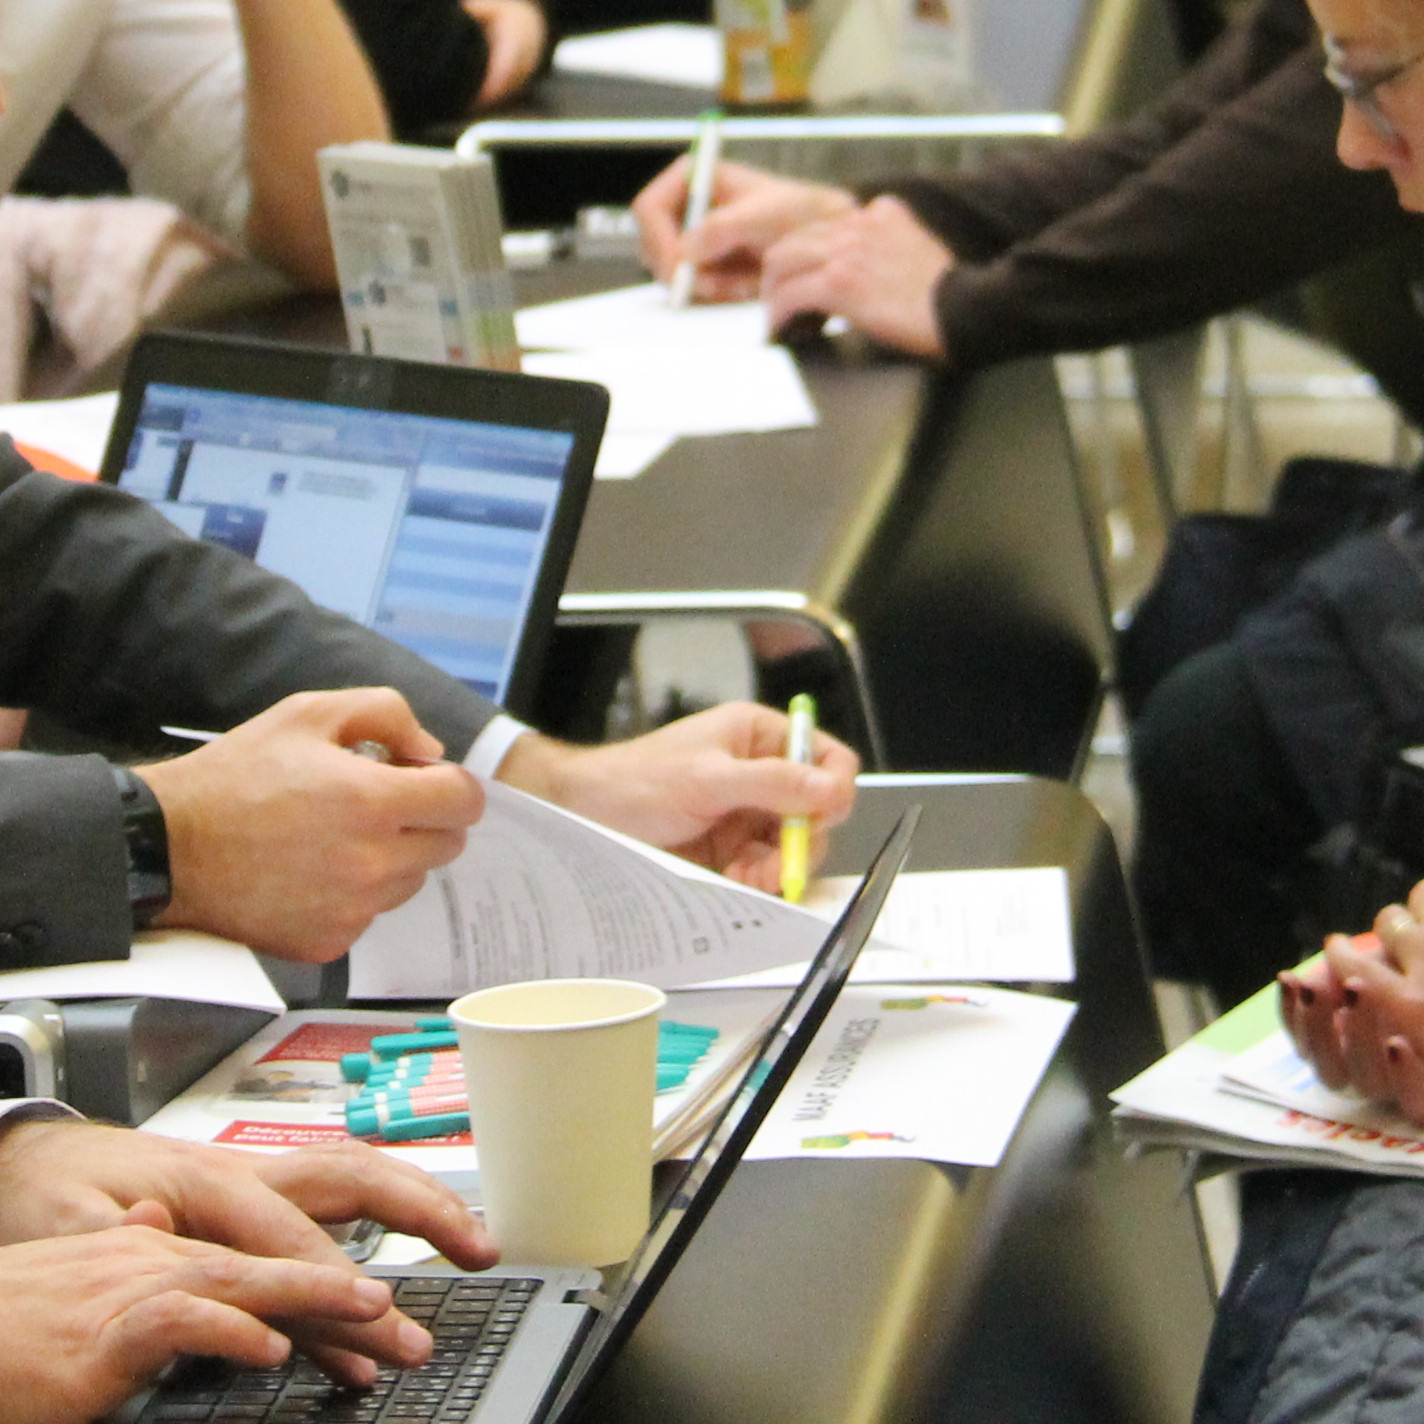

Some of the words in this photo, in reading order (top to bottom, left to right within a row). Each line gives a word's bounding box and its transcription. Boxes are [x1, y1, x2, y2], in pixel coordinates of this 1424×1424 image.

[812, 1017, 880, 1088] ASSURANCES
[790, 1091, 837, 1122] MAAF
[232, 1133, 285, 1143] peut
[241, 1126, 352, 1138] Découvre
